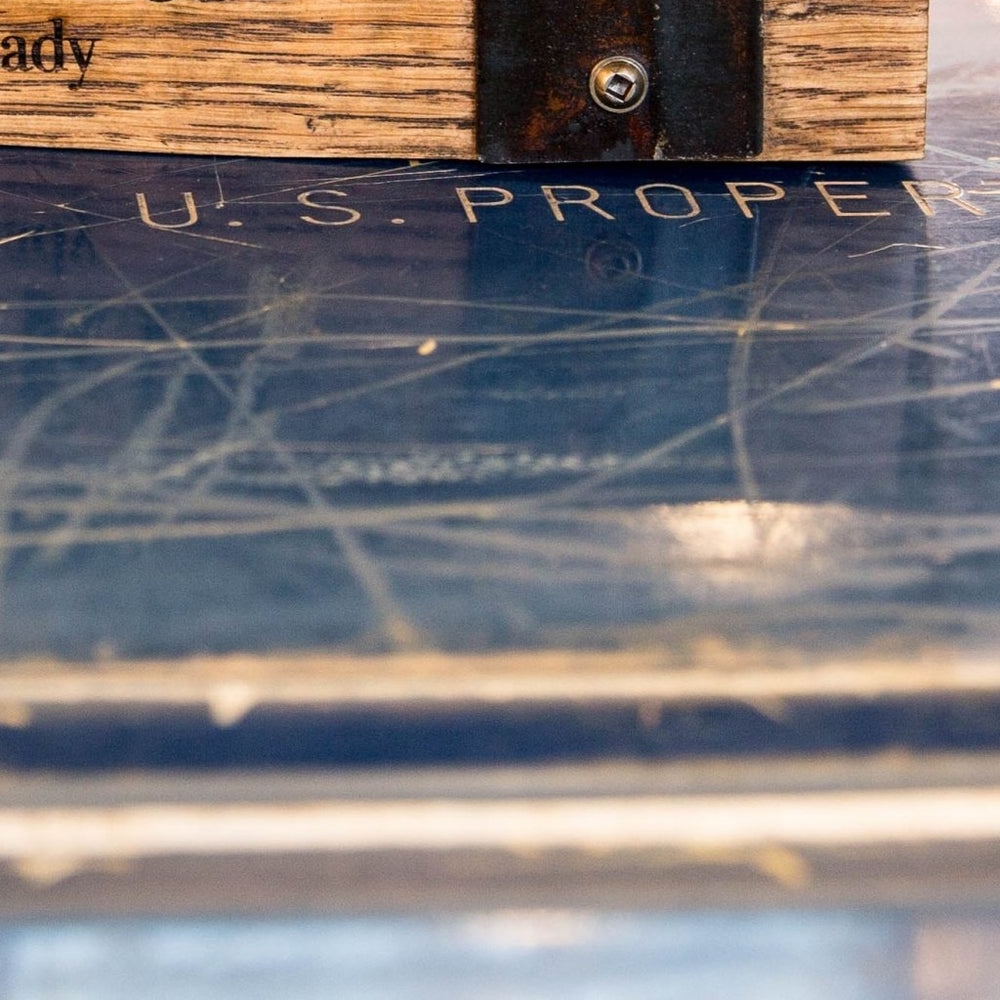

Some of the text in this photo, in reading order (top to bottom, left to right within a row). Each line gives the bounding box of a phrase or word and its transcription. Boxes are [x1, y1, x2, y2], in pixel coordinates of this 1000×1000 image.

[136, 179, 1000, 230] U. S. PROPER
